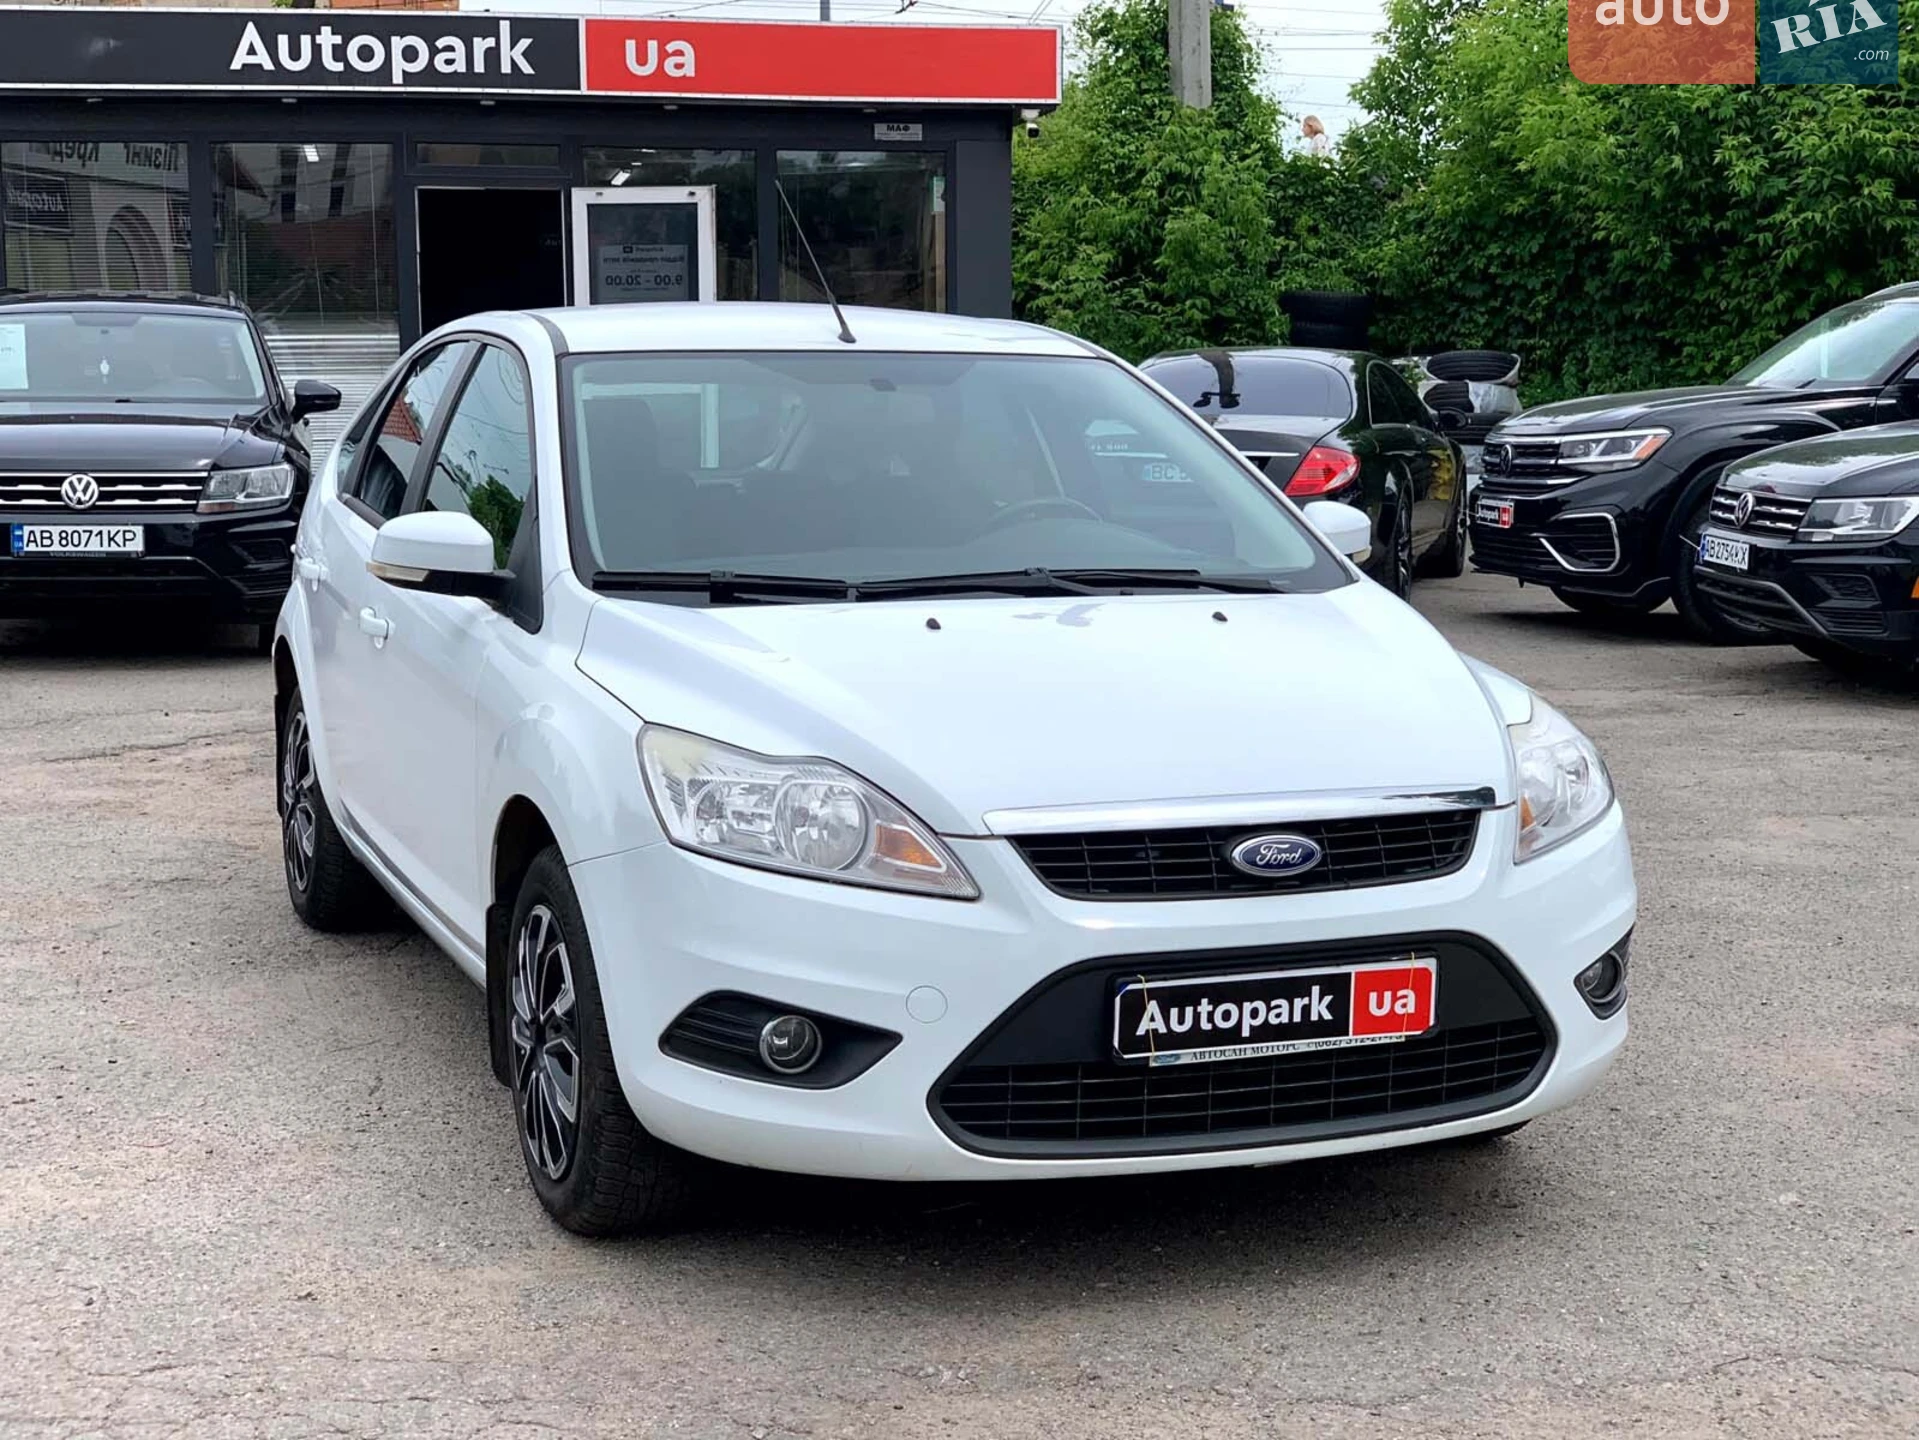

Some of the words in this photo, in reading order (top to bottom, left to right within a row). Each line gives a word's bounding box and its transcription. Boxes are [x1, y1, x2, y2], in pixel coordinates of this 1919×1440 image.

[229, 21, 535, 84] Autopark
[624, 39, 696, 78] ua
[1255, 842, 1303, 866] Ford
[1136, 985, 1333, 1037] Autopark
[1368, 988, 1417, 1016] ua
